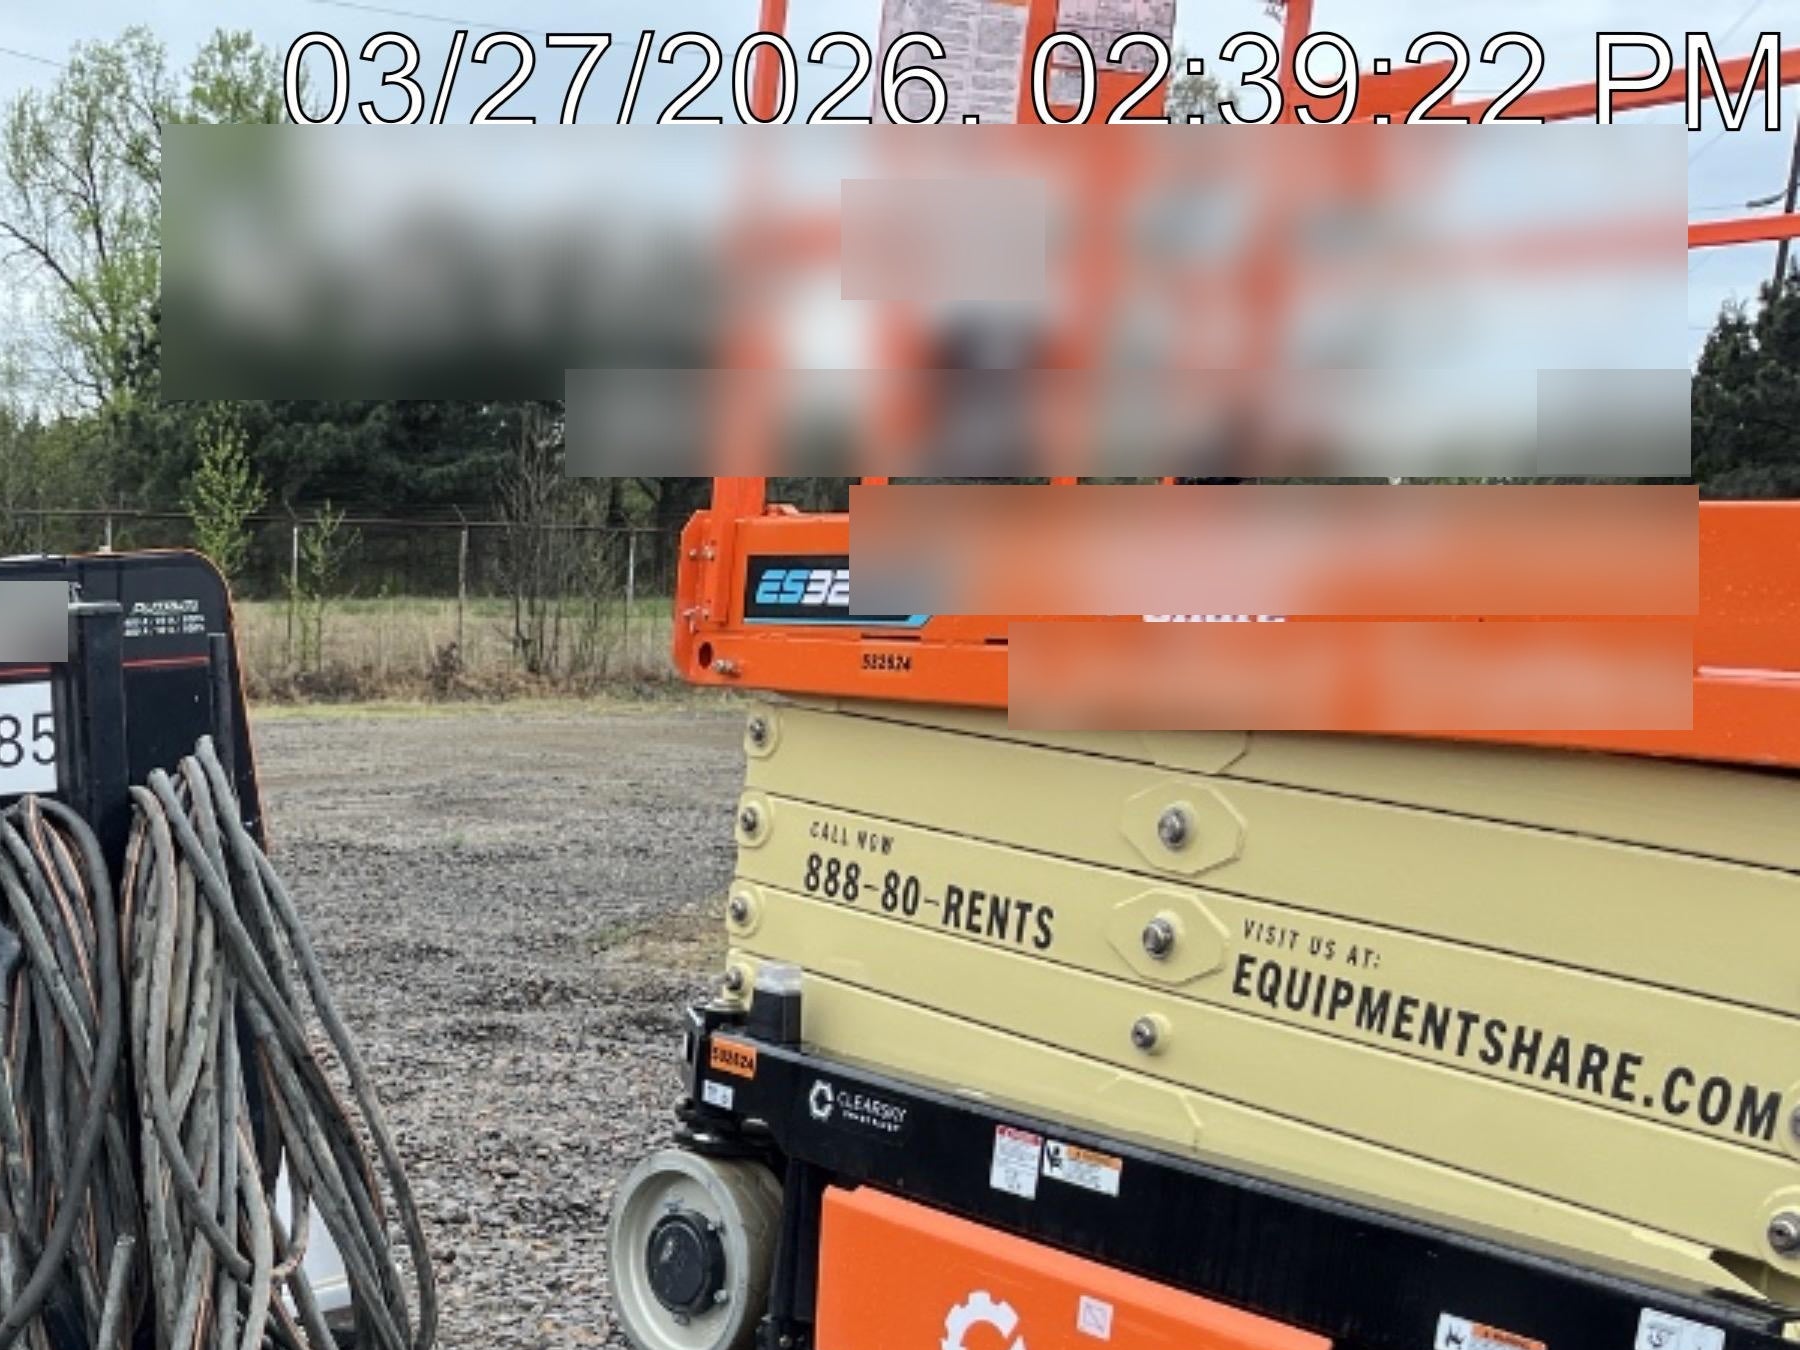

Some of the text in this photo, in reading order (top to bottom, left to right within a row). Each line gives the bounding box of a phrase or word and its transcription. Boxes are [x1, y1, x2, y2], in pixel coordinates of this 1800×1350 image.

[809, 821, 895, 856] CALL NOW
[803, 853, 1056, 949] 888-80-RENTS
[1243, 919, 1382, 970] VISIT US AT:
[1231, 952, 1785, 1142] EQUIPMENTSHARE.COM
[837, 1090, 909, 1124] CLEARSKY
